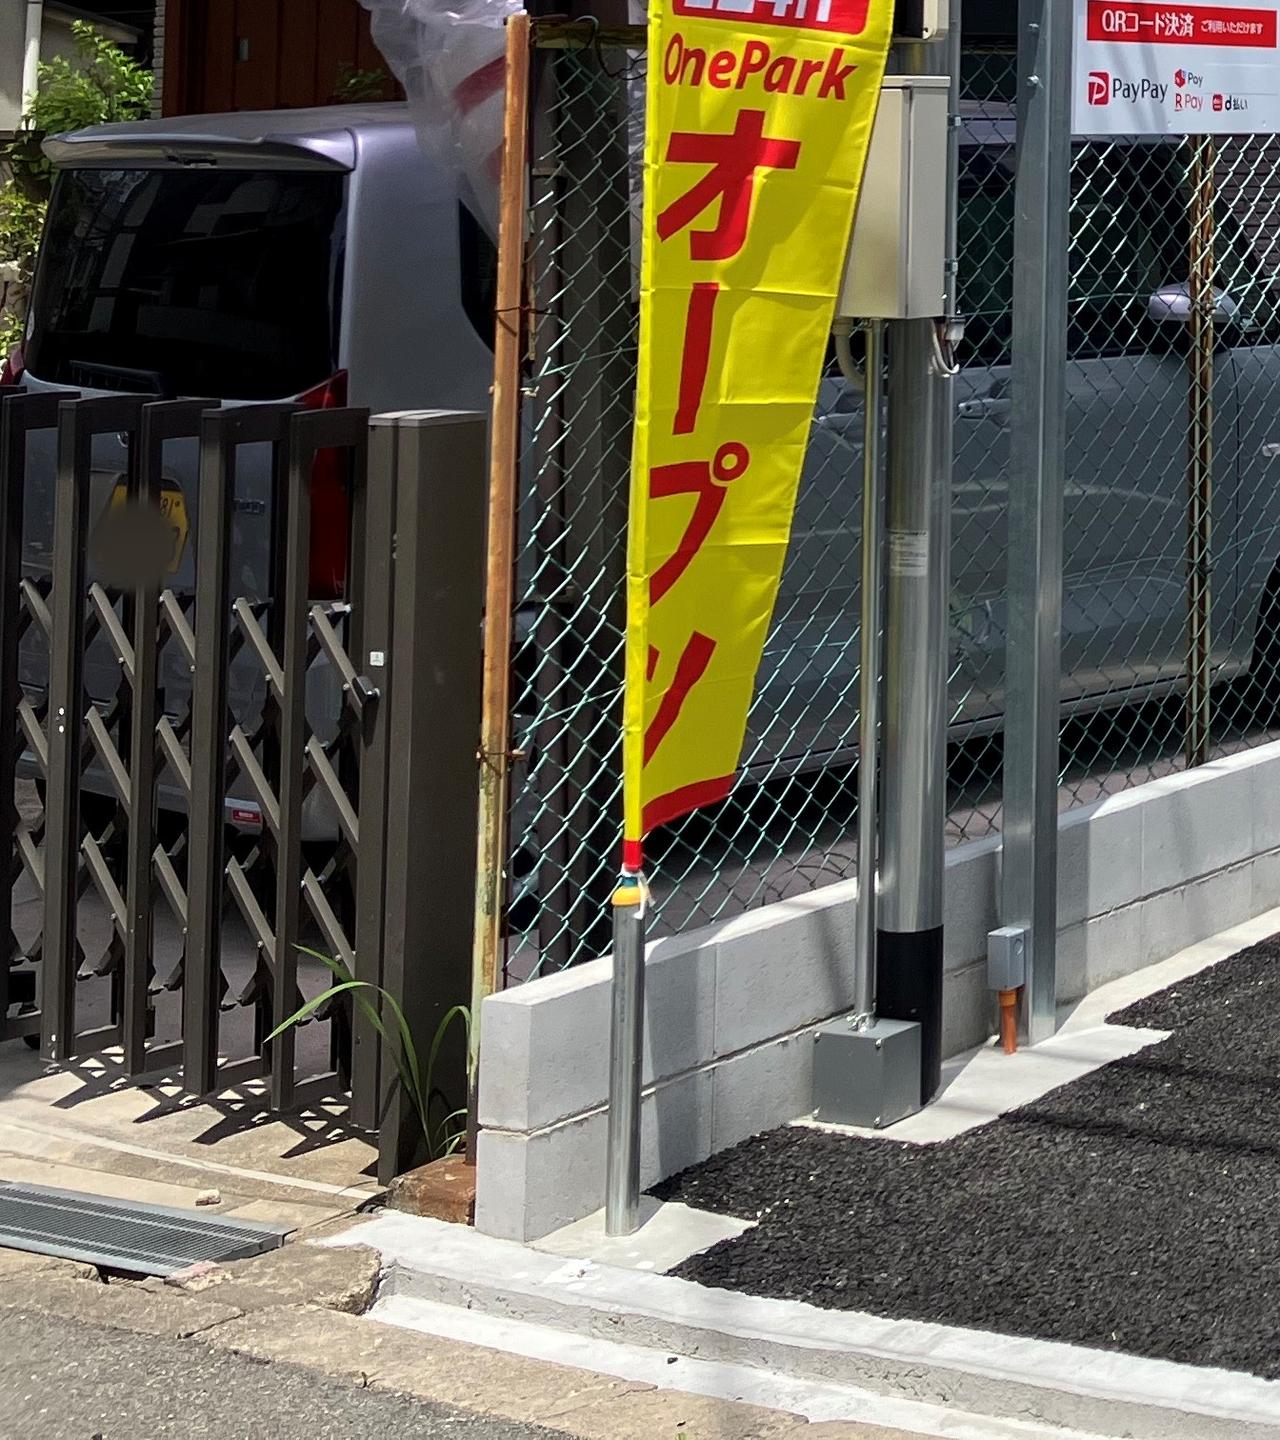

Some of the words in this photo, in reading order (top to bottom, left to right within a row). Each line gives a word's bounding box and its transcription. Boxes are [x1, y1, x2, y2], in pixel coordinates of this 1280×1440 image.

[1101, 9, 1194, 38] QRコード決済
[664, 32, 859, 101] OnePark
[1188, 71, 1204, 88] Pay
[1112, 77, 1168, 104] PayPay
[1185, 93, 1204, 112] Pay
